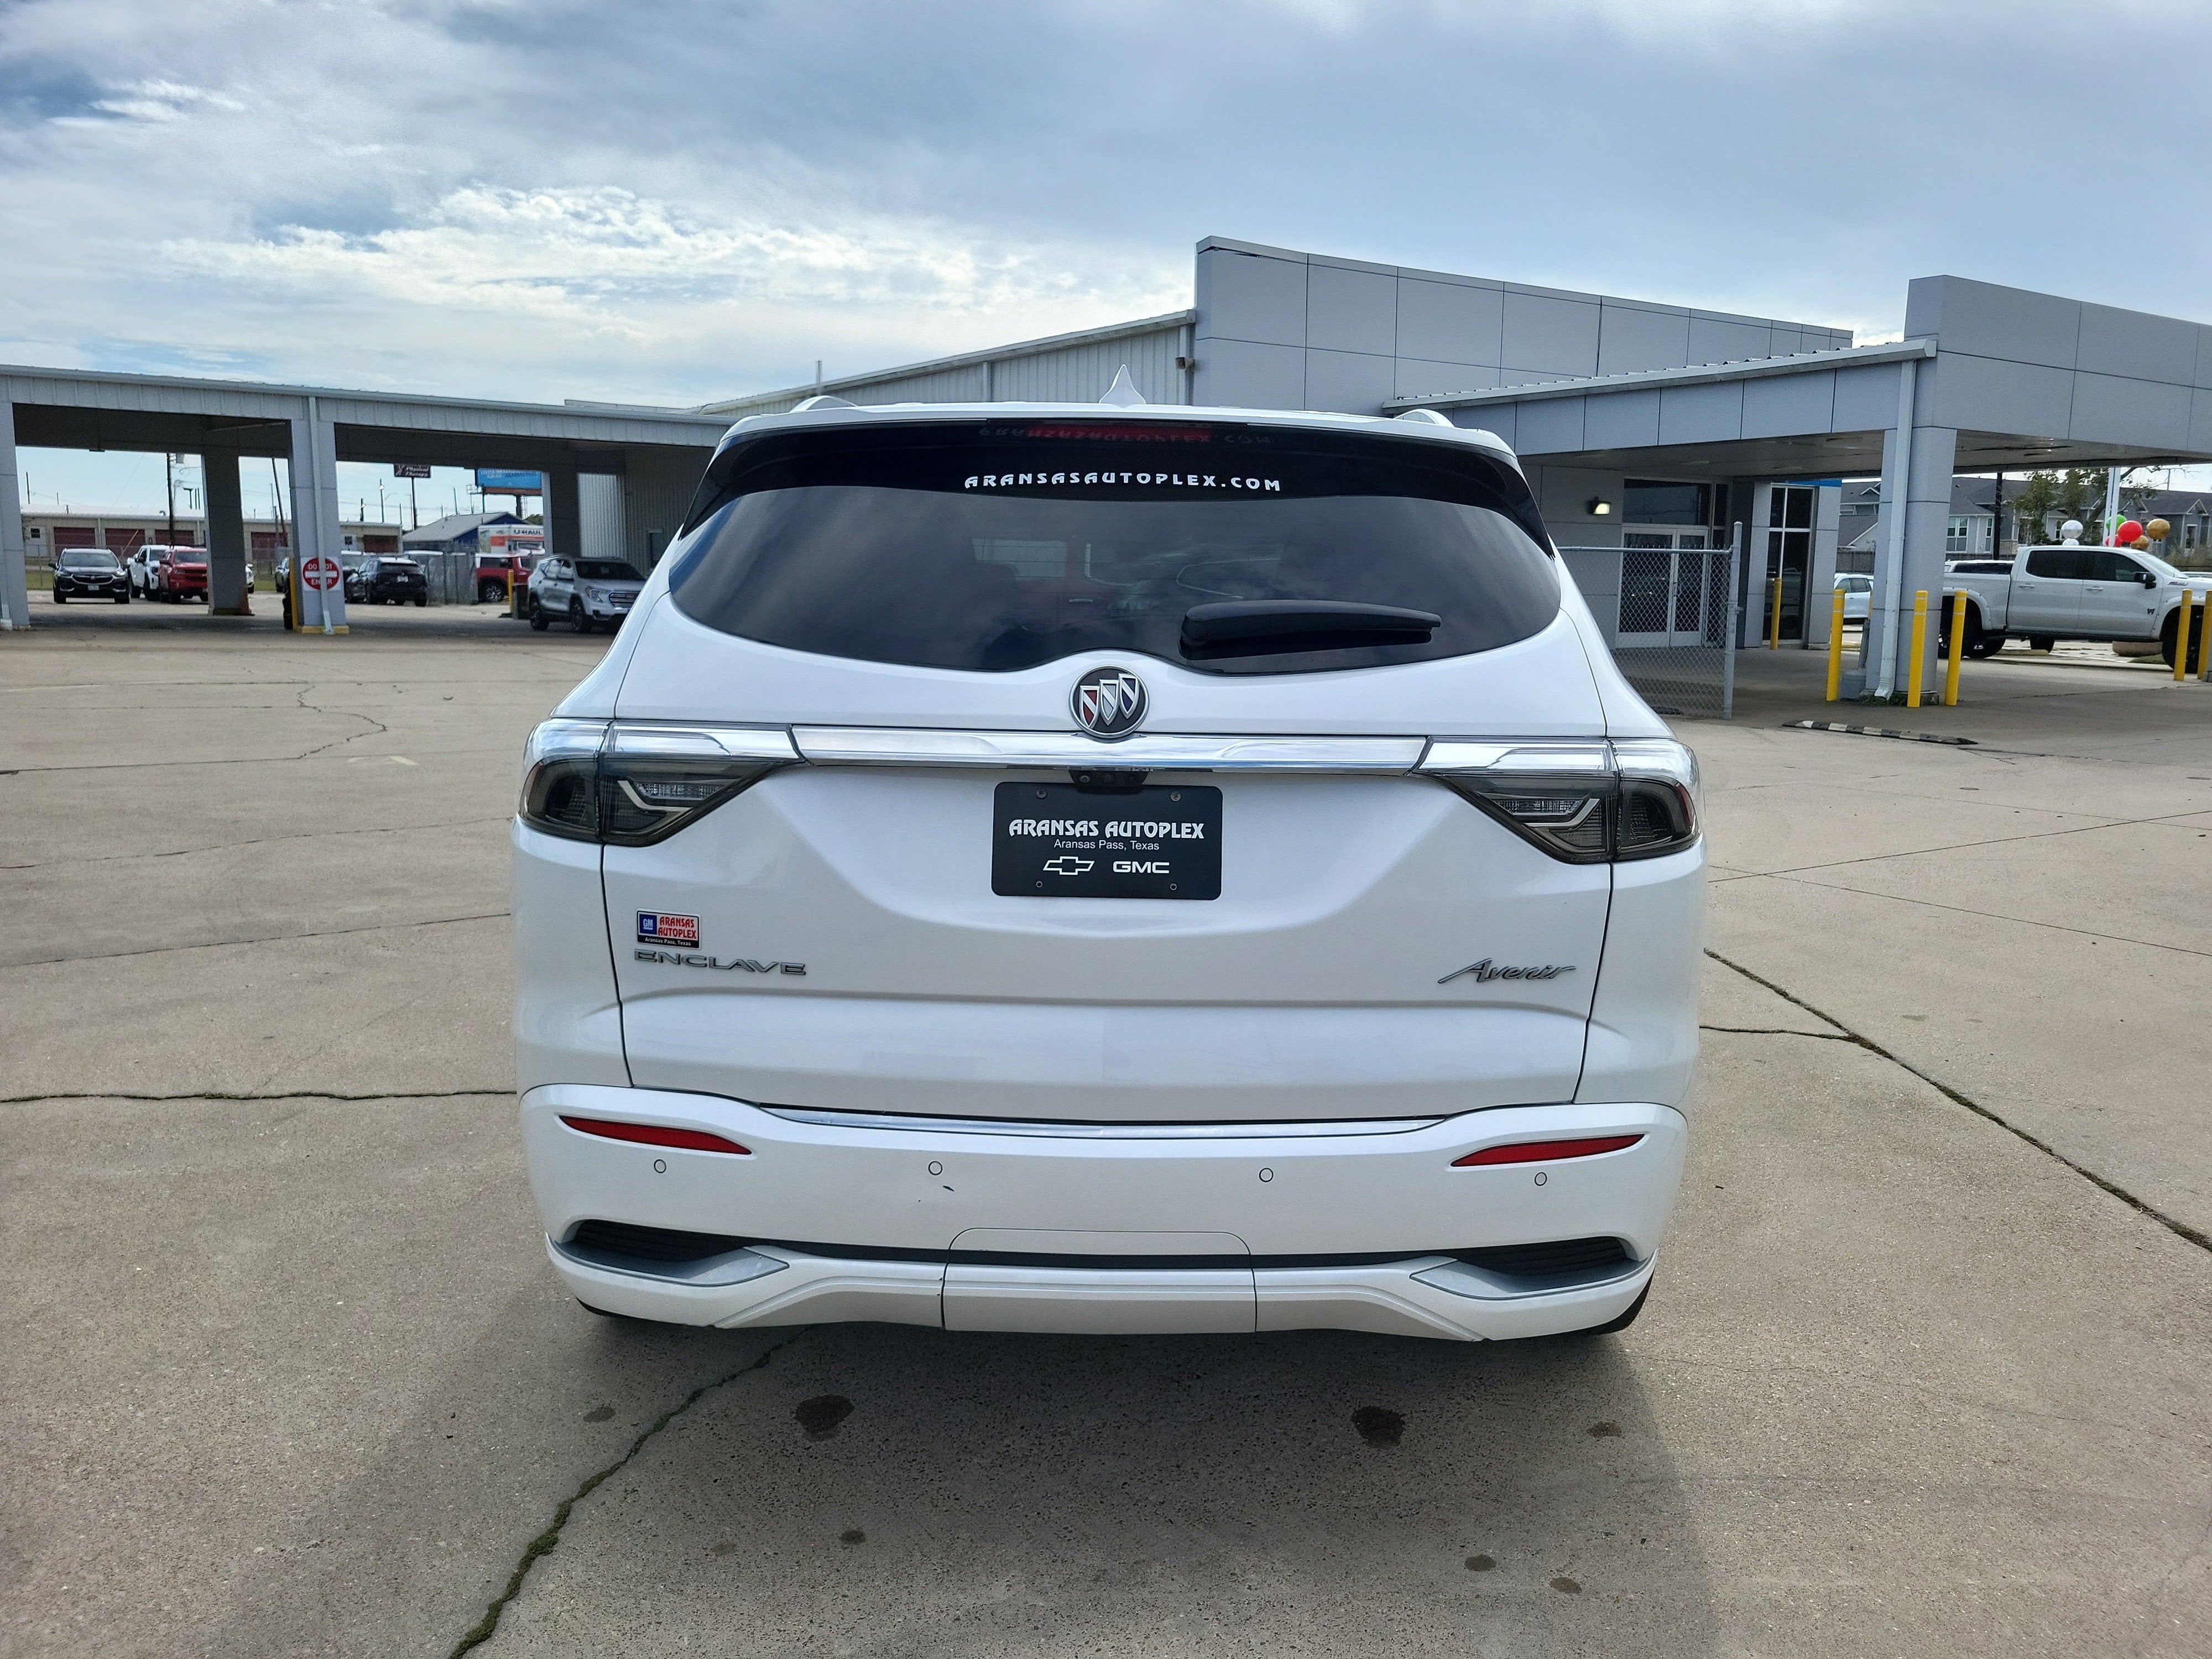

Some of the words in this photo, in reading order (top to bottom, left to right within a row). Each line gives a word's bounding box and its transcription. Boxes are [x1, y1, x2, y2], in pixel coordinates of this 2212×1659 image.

[964, 472, 1281, 492] ARANSASAUTOPLEX.COM
[1009, 819, 1099, 838] ARANSAS
[1105, 821, 1204, 839] AUTOPLEX
[1053, 838, 1096, 849] Aransas
[1098, 839, 1127, 851] Pass,
[1130, 840, 1160, 851] Texas
[1113, 860, 1170, 874] GMC
[643, 919, 653, 928] GM
[659, 916, 695, 928] ARANSAS
[658, 926, 697, 939] AUTOPLEX
[634, 948, 807, 975] ENCLAVE
[1437, 958, 1577, 984] Avenir
